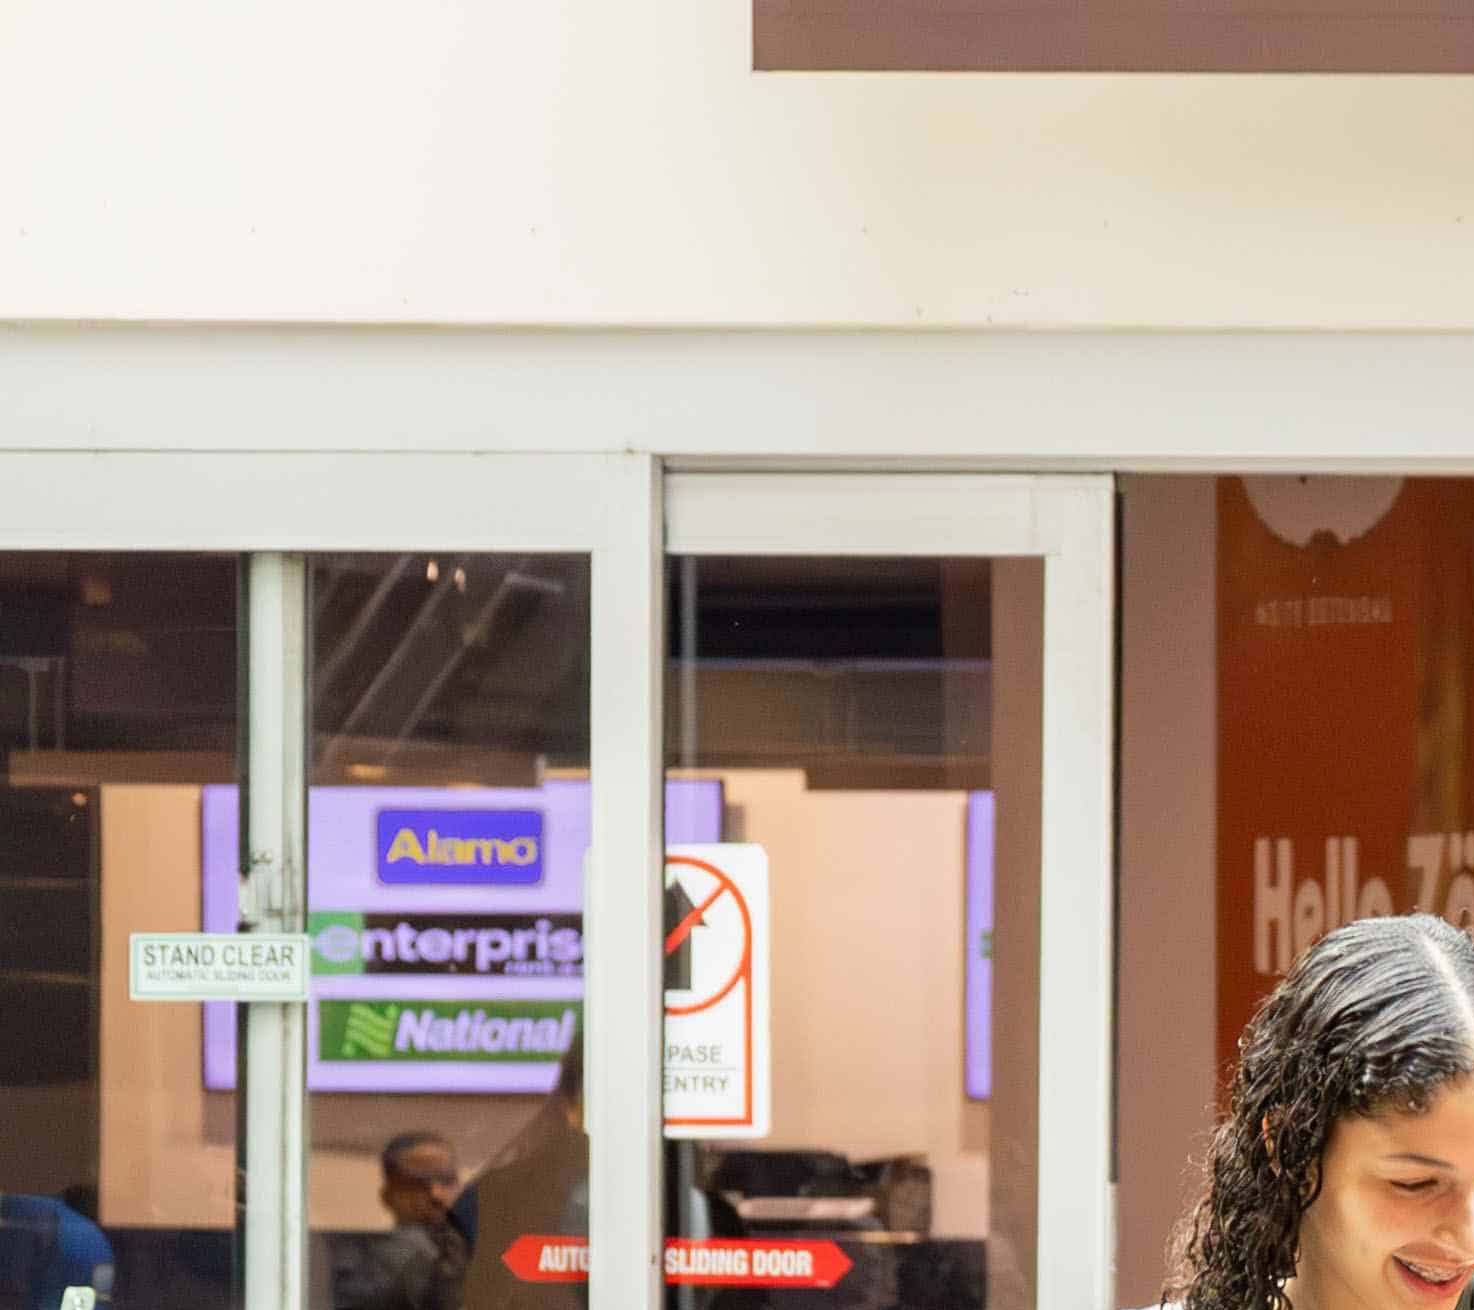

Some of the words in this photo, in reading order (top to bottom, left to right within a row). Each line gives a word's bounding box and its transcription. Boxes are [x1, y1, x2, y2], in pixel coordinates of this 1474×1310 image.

[386, 828, 537, 865] Alamo
[144, 944, 215, 966] STAND
[223, 944, 295, 966] CLEAR
[315, 919, 584, 973] enterpris
[395, 1009, 576, 1055] National
[664, 1247, 748, 1275] SLIDING
[752, 1249, 813, 1277] DOOR
